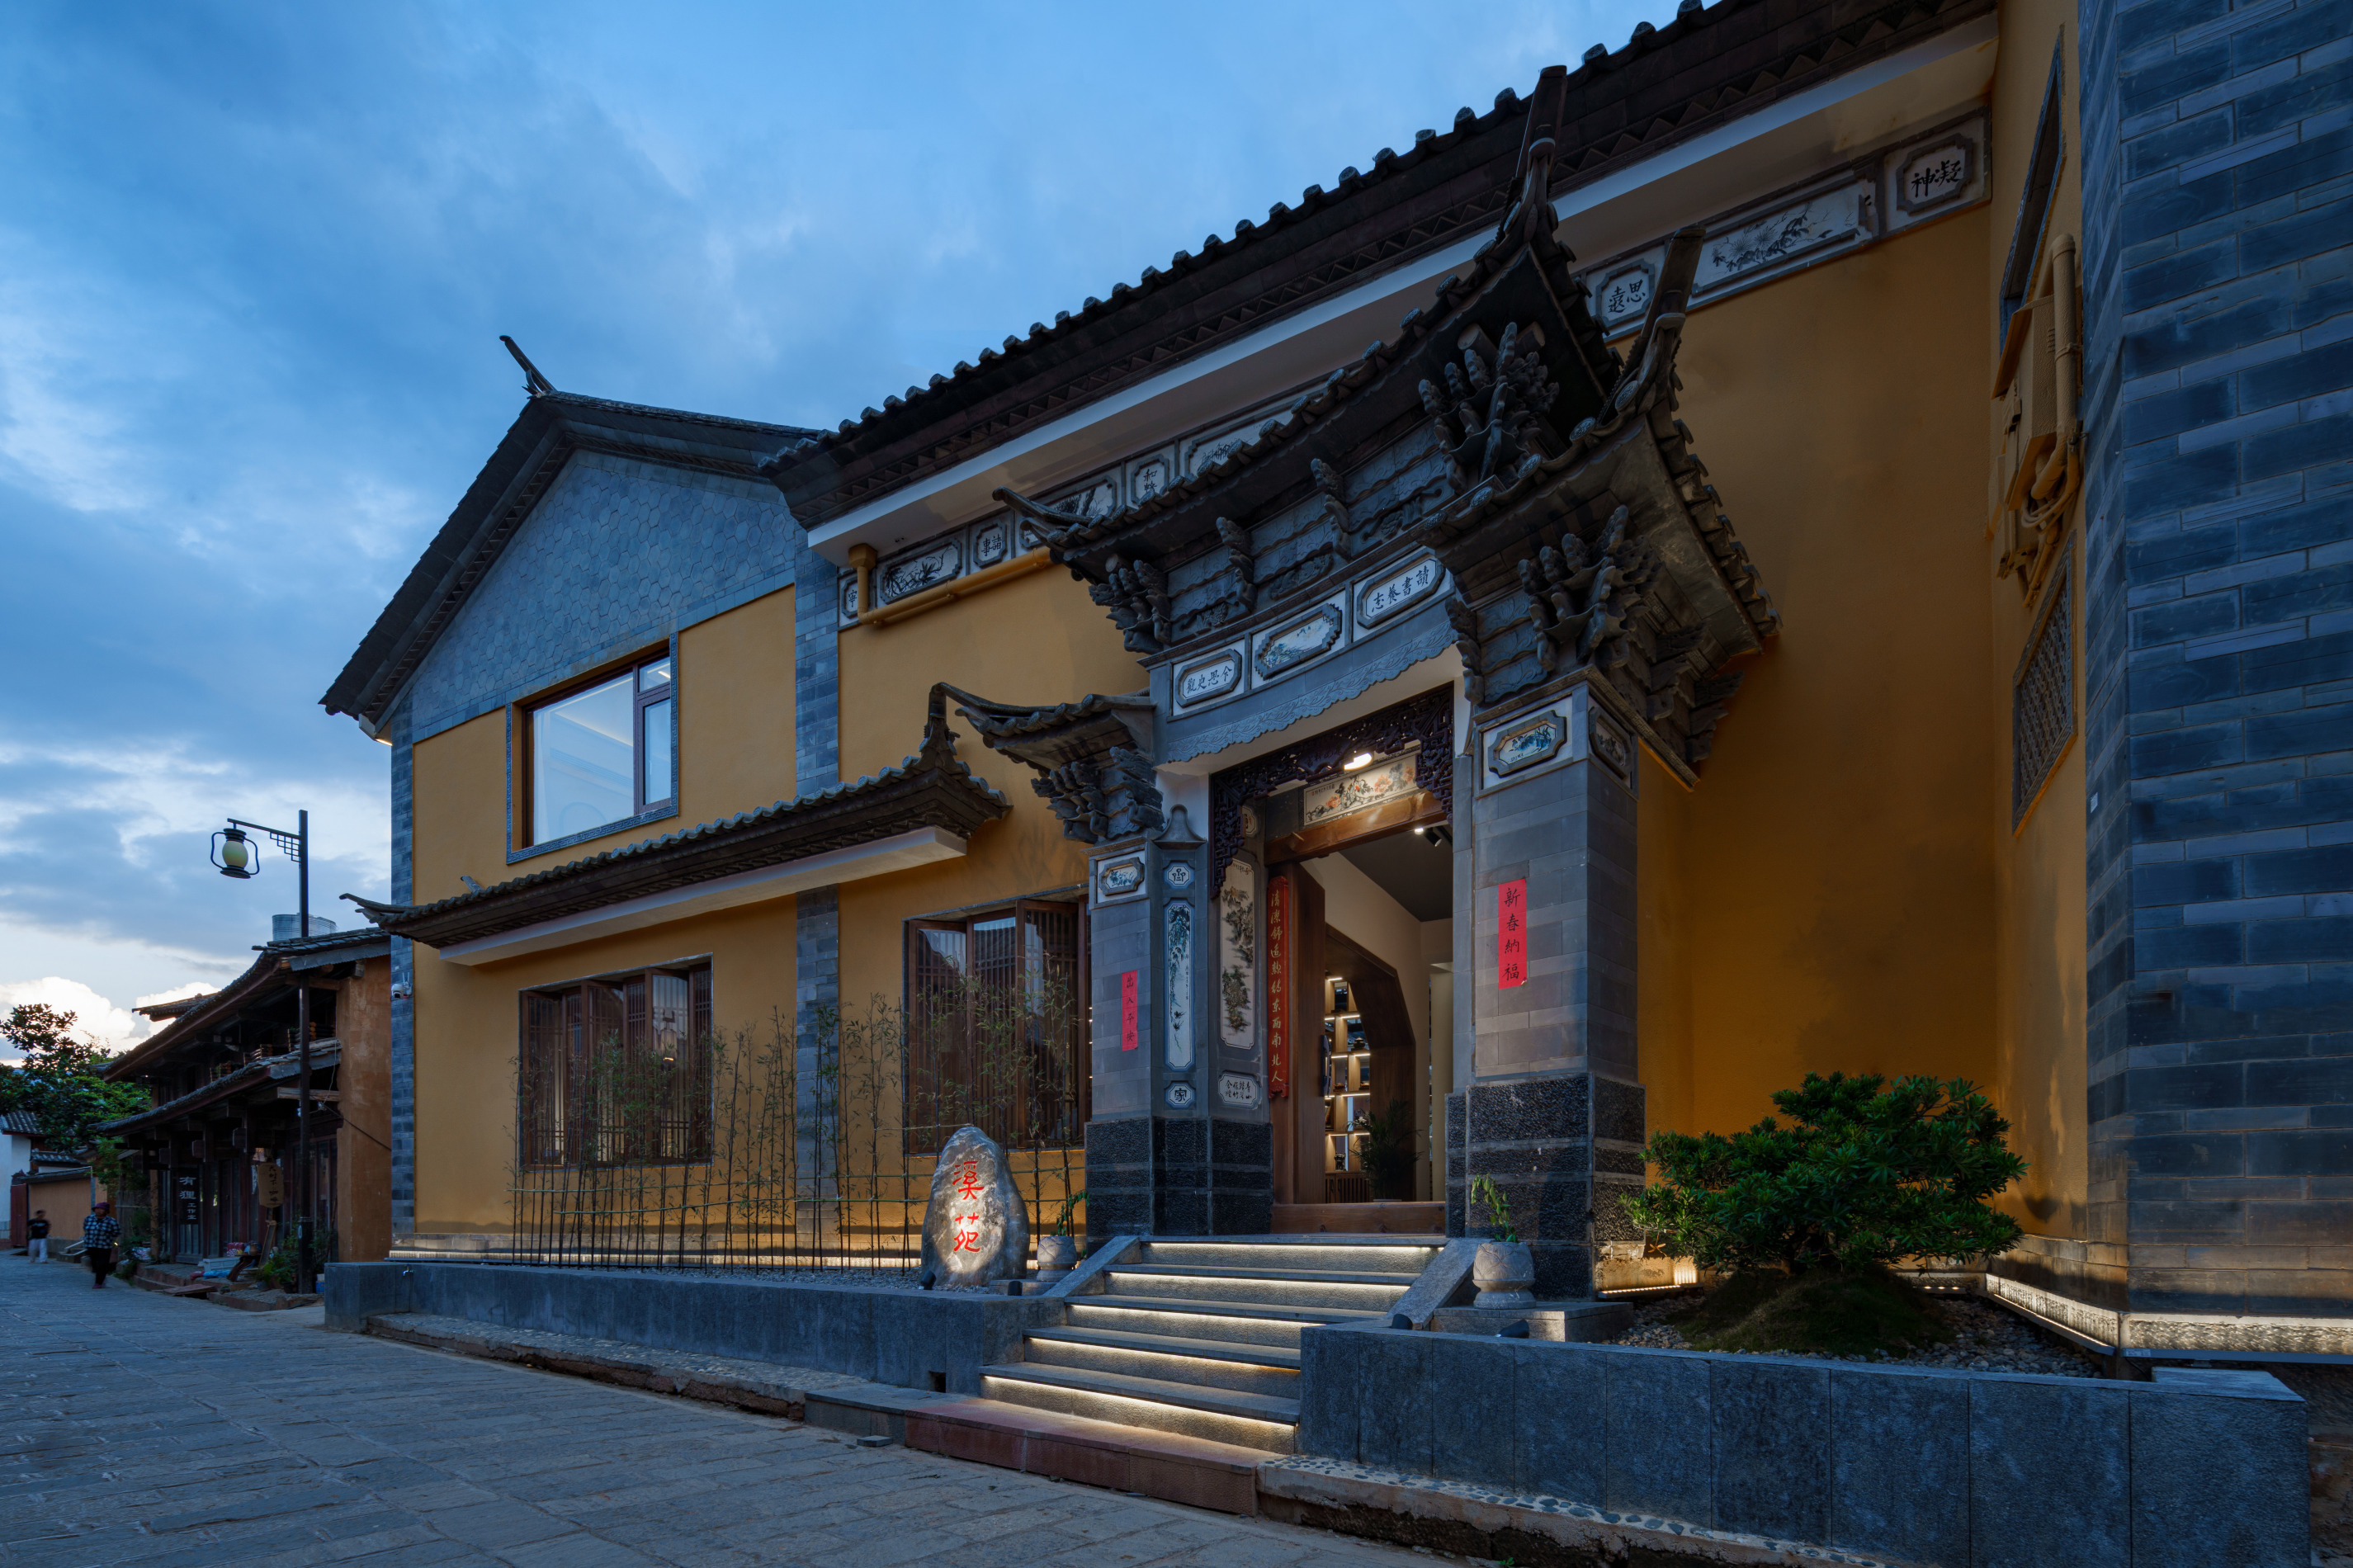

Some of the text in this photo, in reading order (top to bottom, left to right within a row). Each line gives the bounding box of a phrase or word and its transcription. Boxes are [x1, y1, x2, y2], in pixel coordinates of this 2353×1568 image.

[1502, 887, 1520, 981] 新春納福
[1127, 974, 1135, 1041] 出入平安
[1174, 1087, 1187, 1102] 家
[952, 1159, 985, 1253] 溪苑
